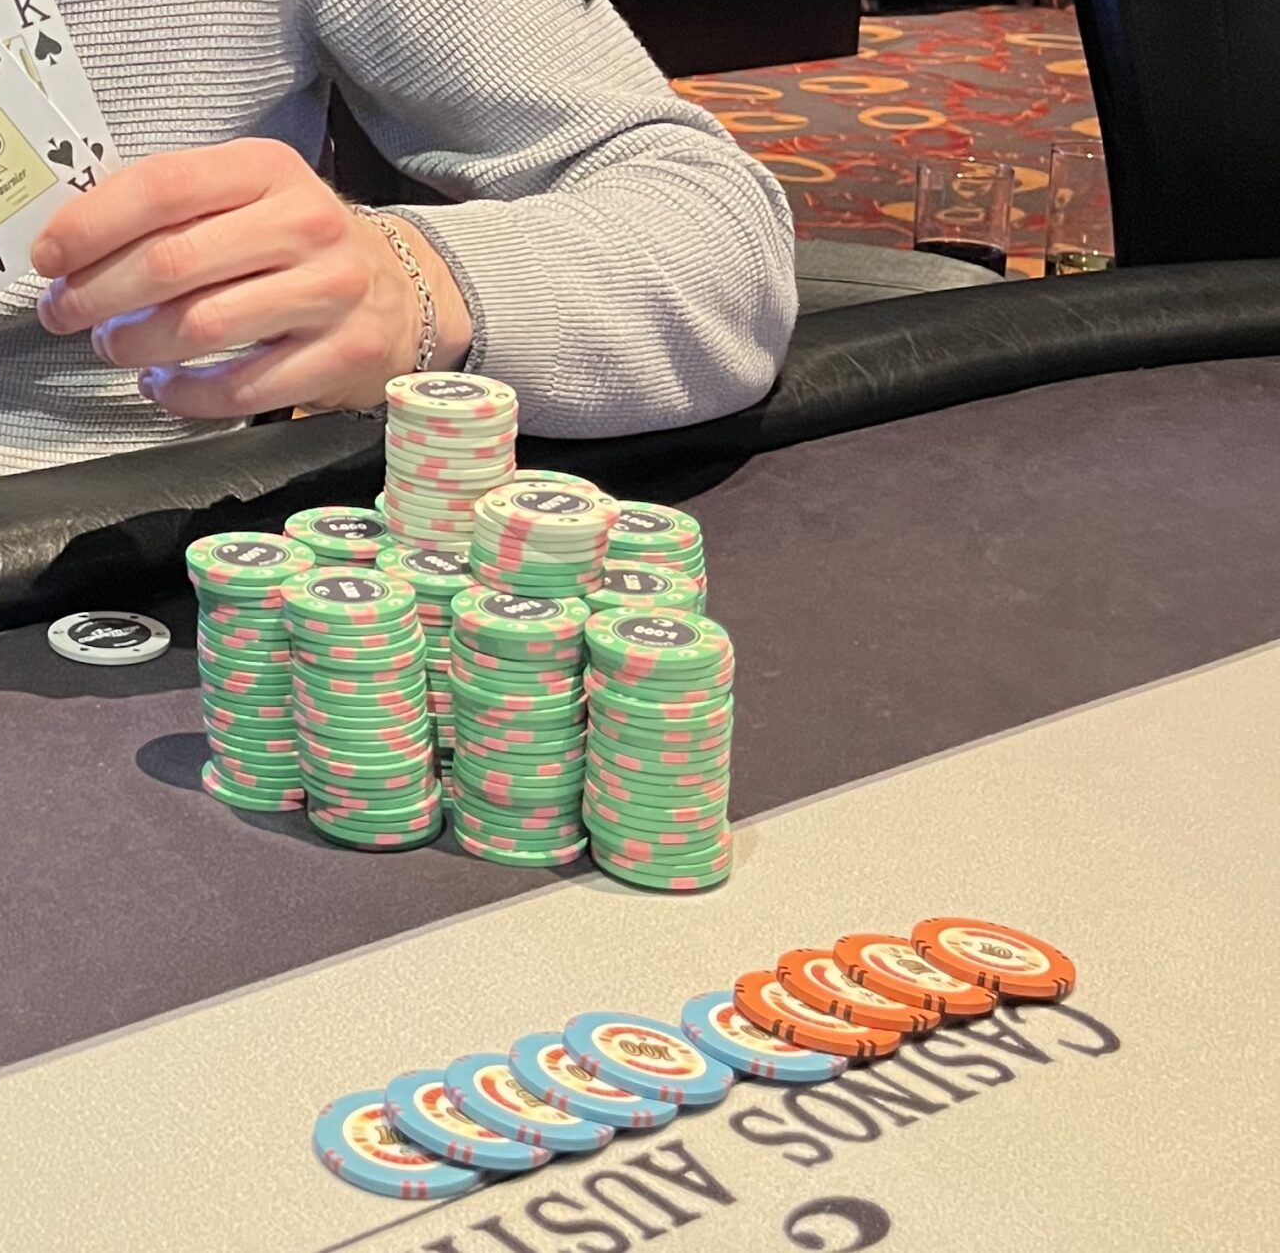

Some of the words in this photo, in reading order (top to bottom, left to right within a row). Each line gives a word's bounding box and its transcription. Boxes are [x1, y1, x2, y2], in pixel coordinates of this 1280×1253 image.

[978, 941, 1013, 960] 10
[619, 1038, 678, 1062] 100
[729, 1002, 1121, 1168] CASINOS
[406, 1139, 737, 1253] AUST
